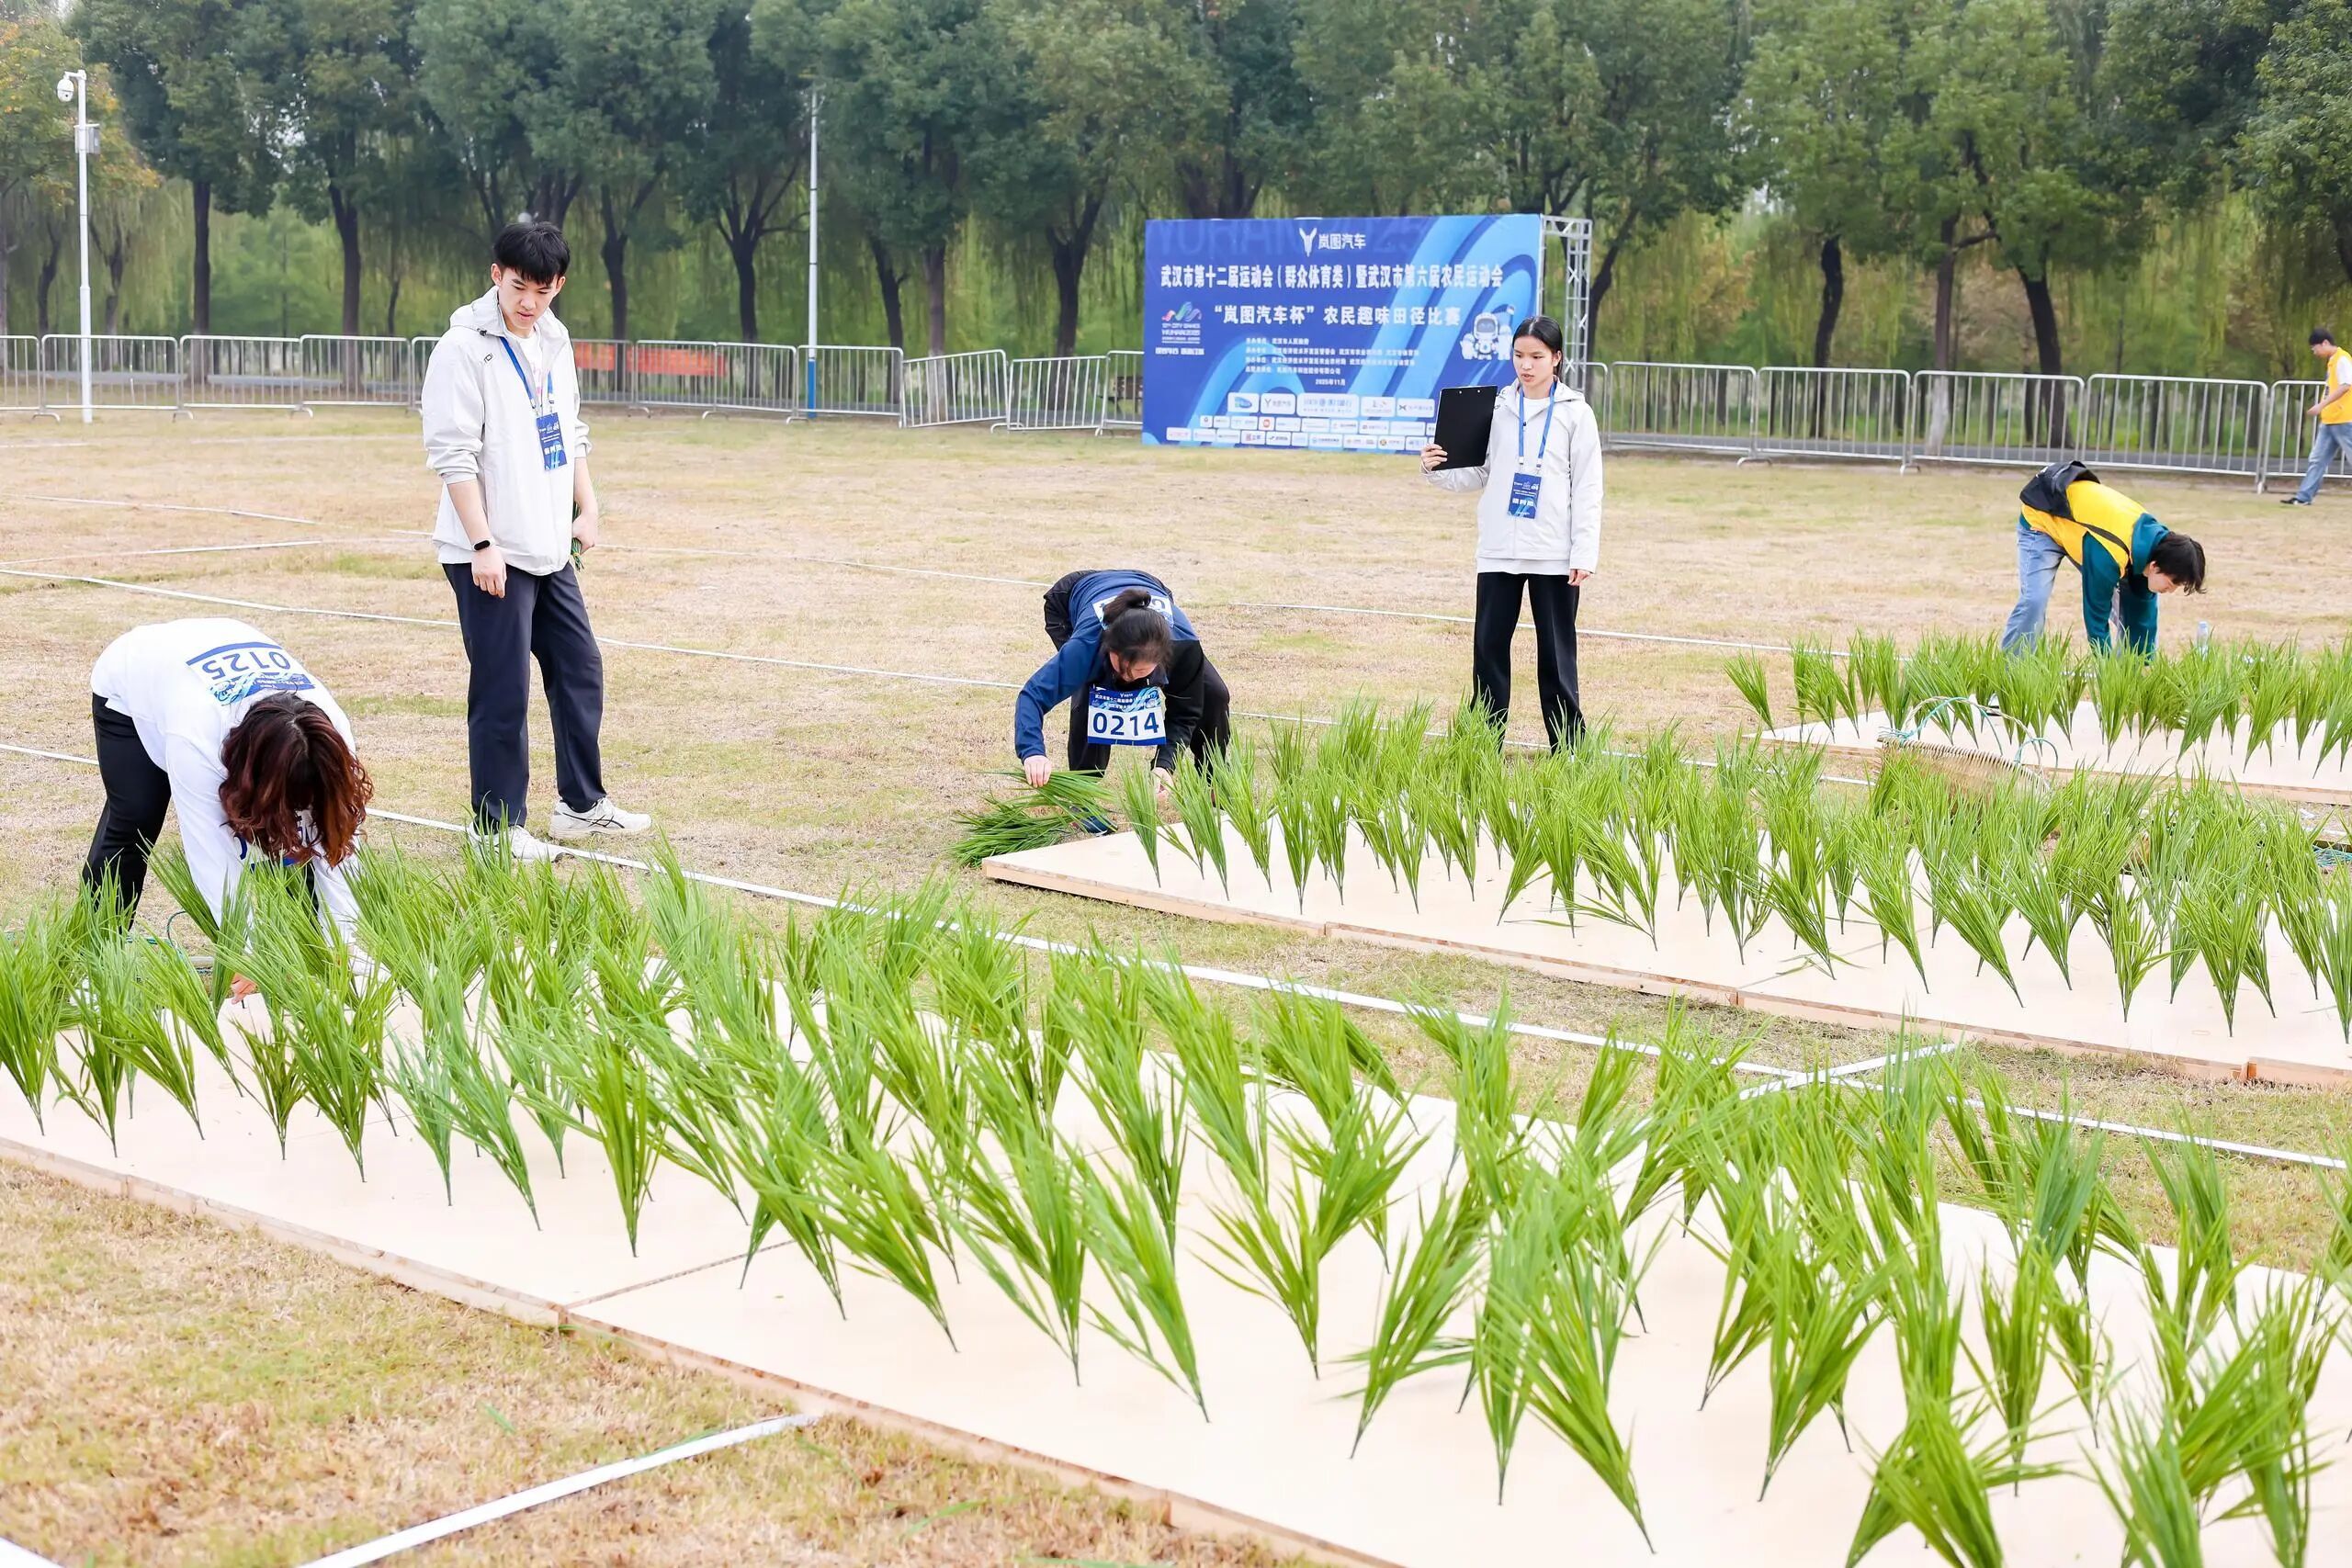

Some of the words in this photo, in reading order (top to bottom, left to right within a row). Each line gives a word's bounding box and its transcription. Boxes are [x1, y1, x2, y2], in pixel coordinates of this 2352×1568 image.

[1317, 233, 1366, 250] 岚图汽车
[202, 651, 290, 680] 0125
[1093, 712, 1159, 736] 0214
